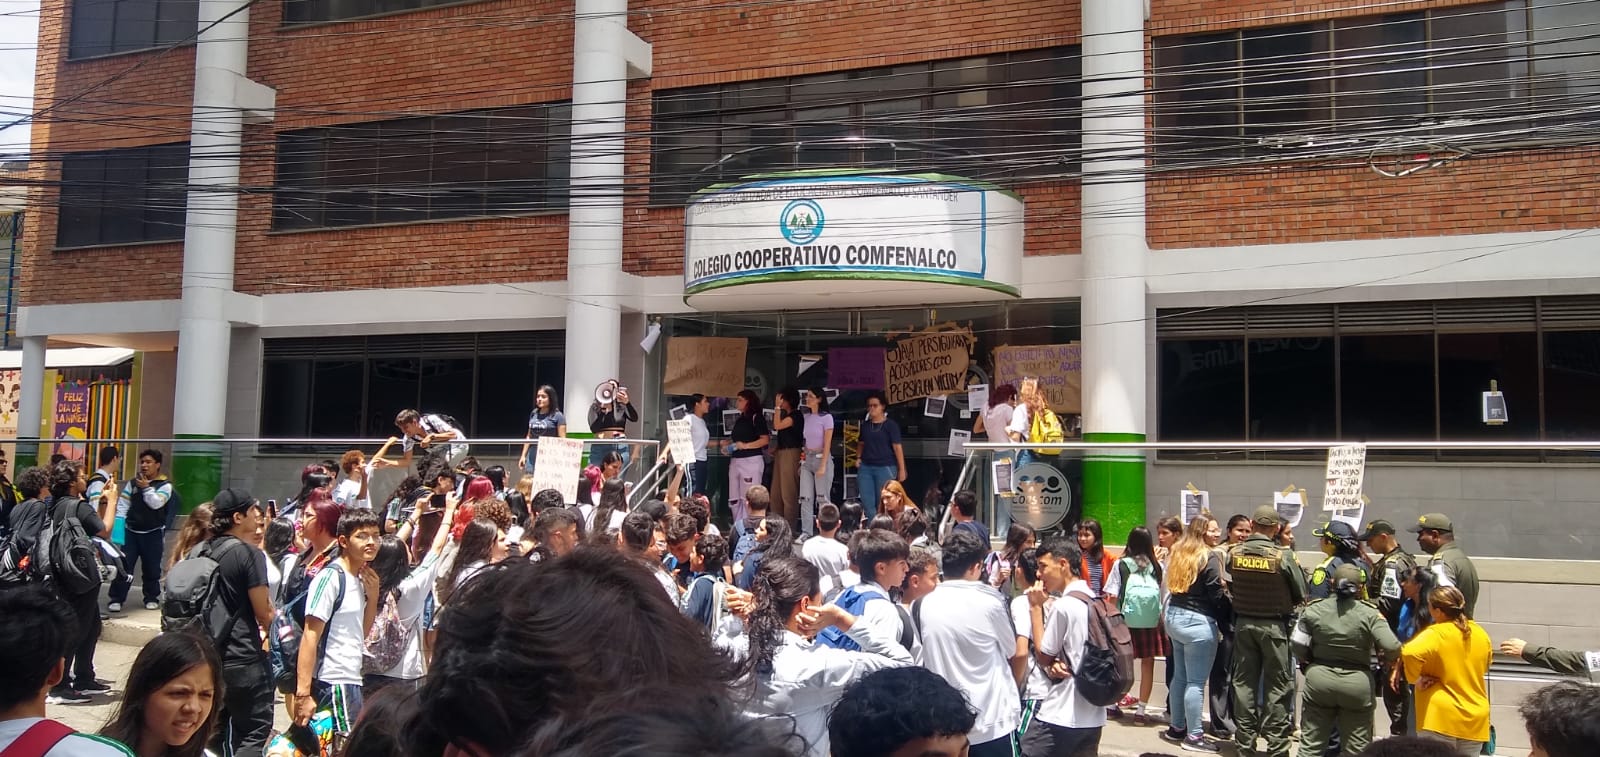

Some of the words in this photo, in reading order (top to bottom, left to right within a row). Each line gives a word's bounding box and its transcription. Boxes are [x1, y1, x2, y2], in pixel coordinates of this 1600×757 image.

[693, 253, 731, 279] COLEGIO
[734, 245, 841, 270] COOPERATIVO
[846, 245, 957, 269] COMFENALCO
[63, 392, 84, 402] FELIZ
[71, 403, 81, 413] DE
[55, 414, 65, 423] LA
[1342, 468, 1360, 477] HIJAS
